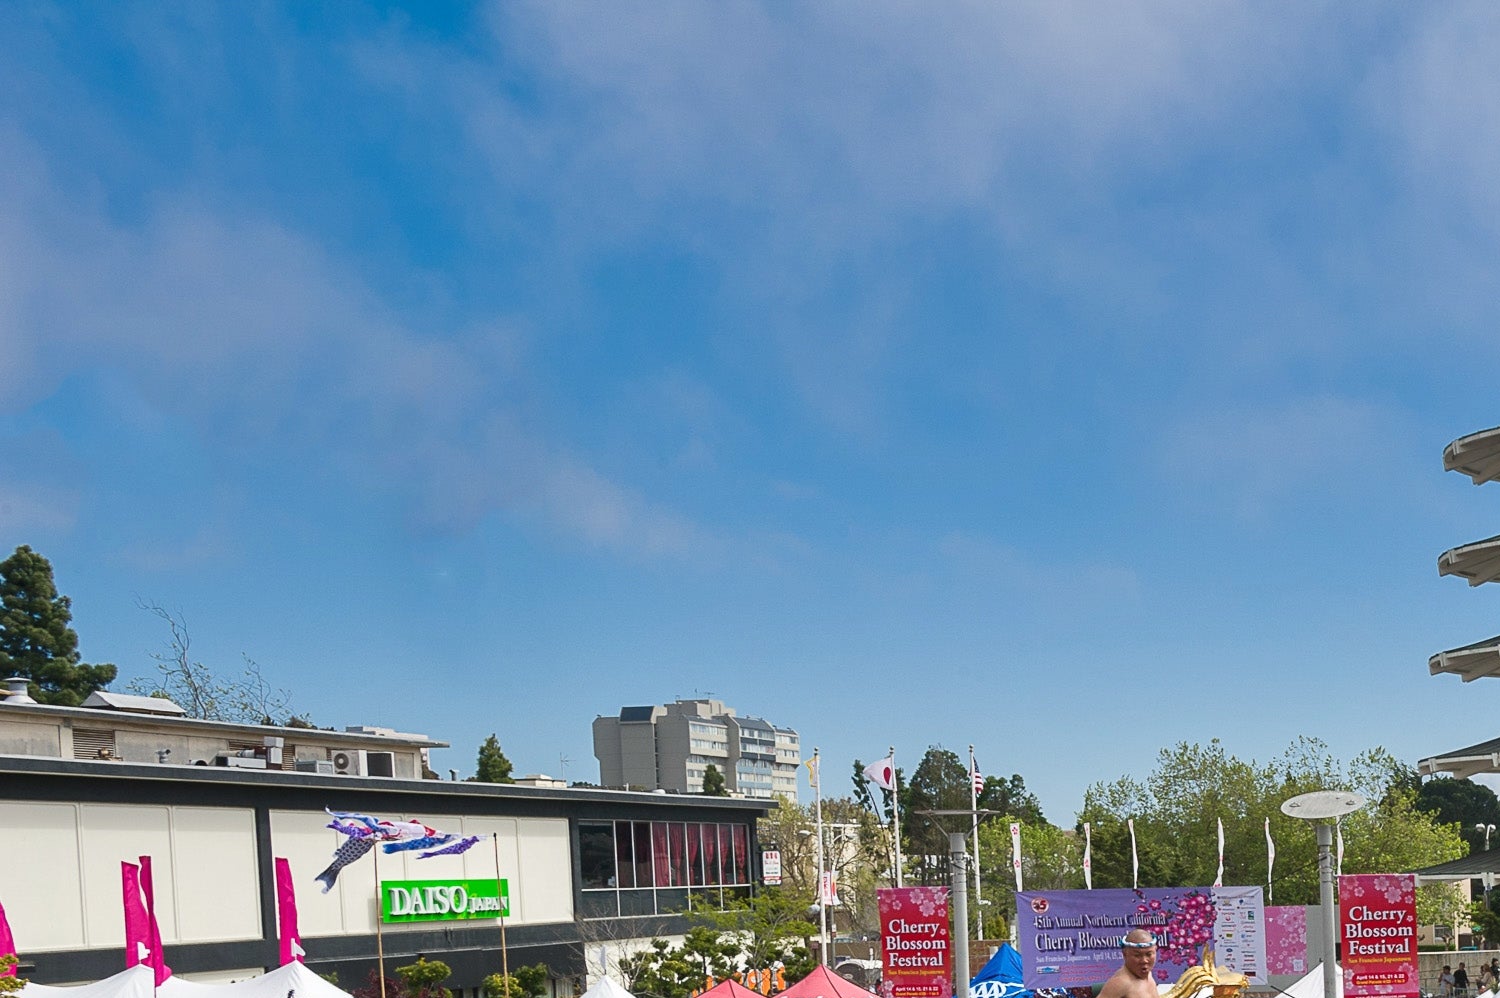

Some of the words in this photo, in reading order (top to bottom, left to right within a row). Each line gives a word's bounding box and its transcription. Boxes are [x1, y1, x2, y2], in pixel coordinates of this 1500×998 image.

[389, 886, 468, 916] DAISO
[468, 896, 509, 913] JAPAN
[1034, 915, 1052, 928] 45th
[1054, 913, 1084, 927] Annual
[1085, 912, 1123, 926] Northern
[1124, 911, 1166, 926] California
[1349, 906, 1406, 925] Cherry
[888, 919, 940, 937] Cherry
[1345, 924, 1413, 939] Blossom
[886, 936, 946, 951] Blossom
[1035, 933, 1075, 953] Cherry
[1078, 931, 1122, 950] Blossom
[1349, 938, 1409, 956] Festival
[889, 953, 944, 967] Festival
